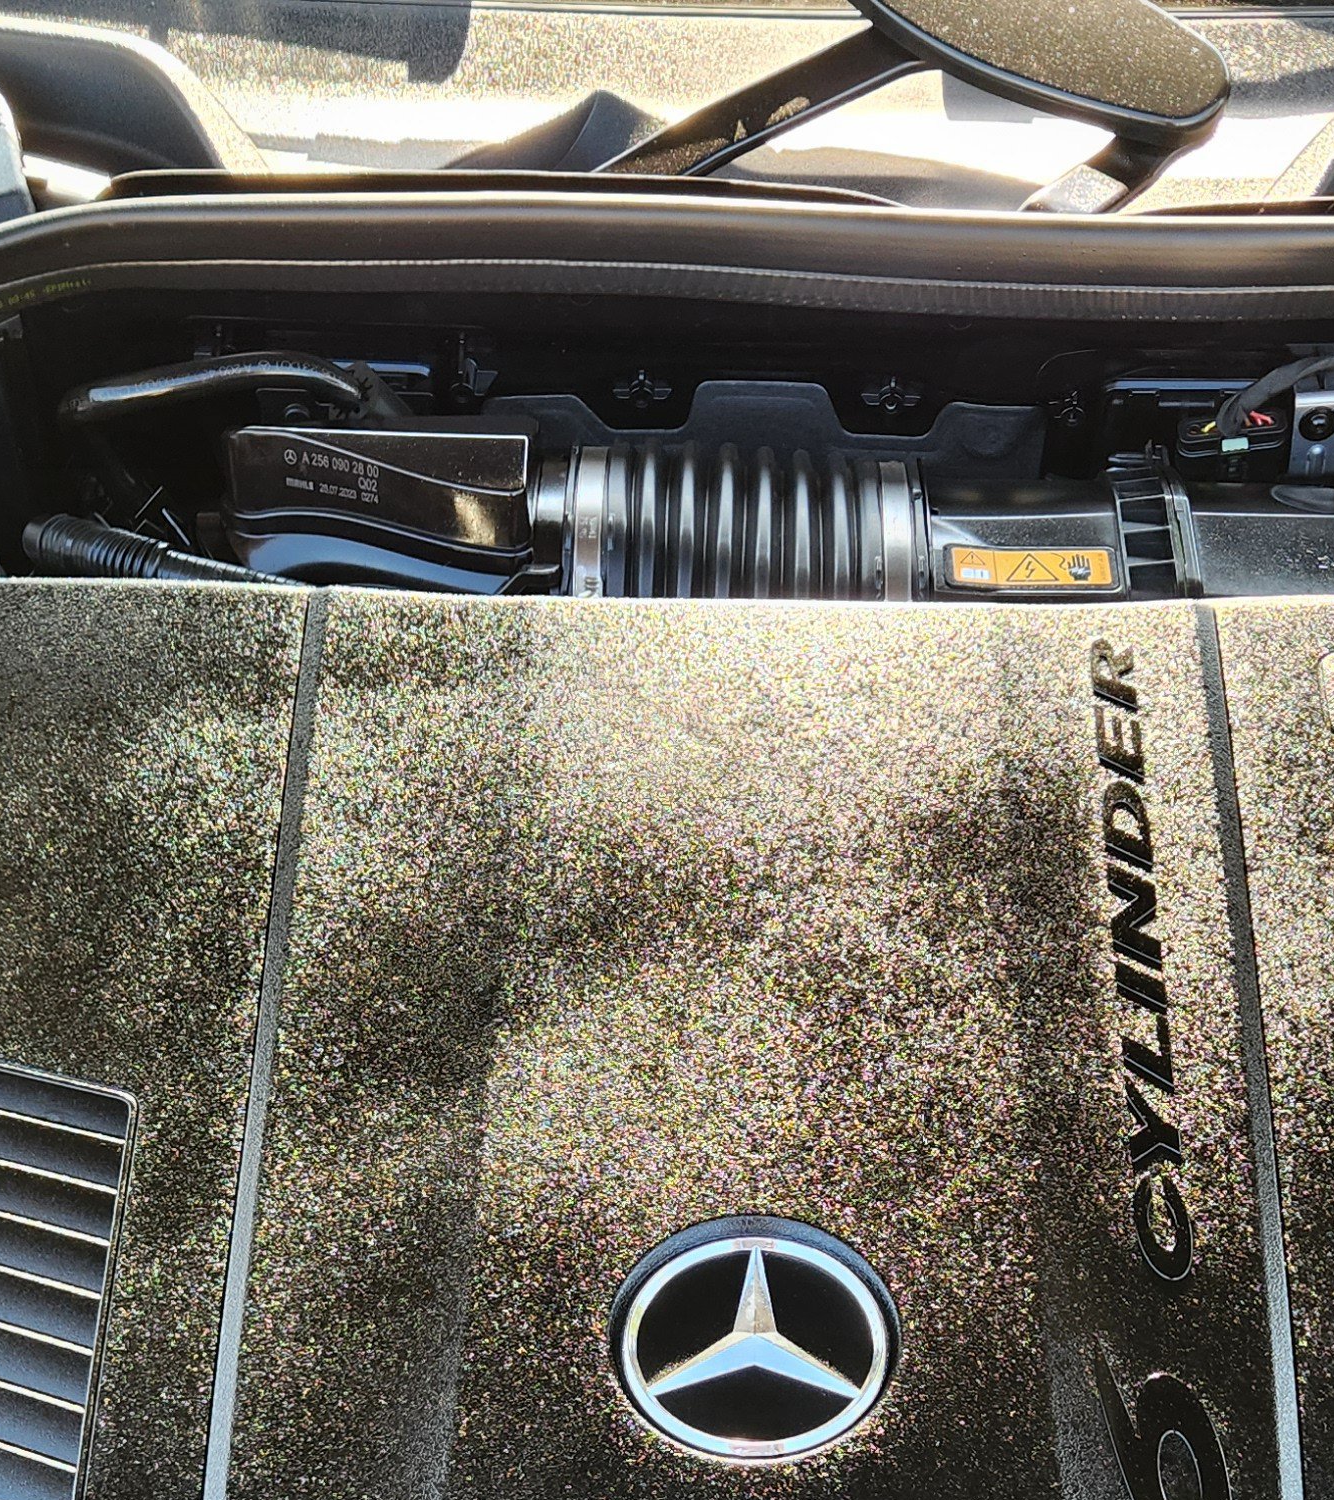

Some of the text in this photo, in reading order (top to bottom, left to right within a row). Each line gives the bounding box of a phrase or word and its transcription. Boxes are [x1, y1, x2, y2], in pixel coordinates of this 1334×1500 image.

[301, 451, 379, 479] A 256 090 28 00
[357, 477, 378, 492] Q02
[1090, 636, 1195, 1284] CYLINDER
